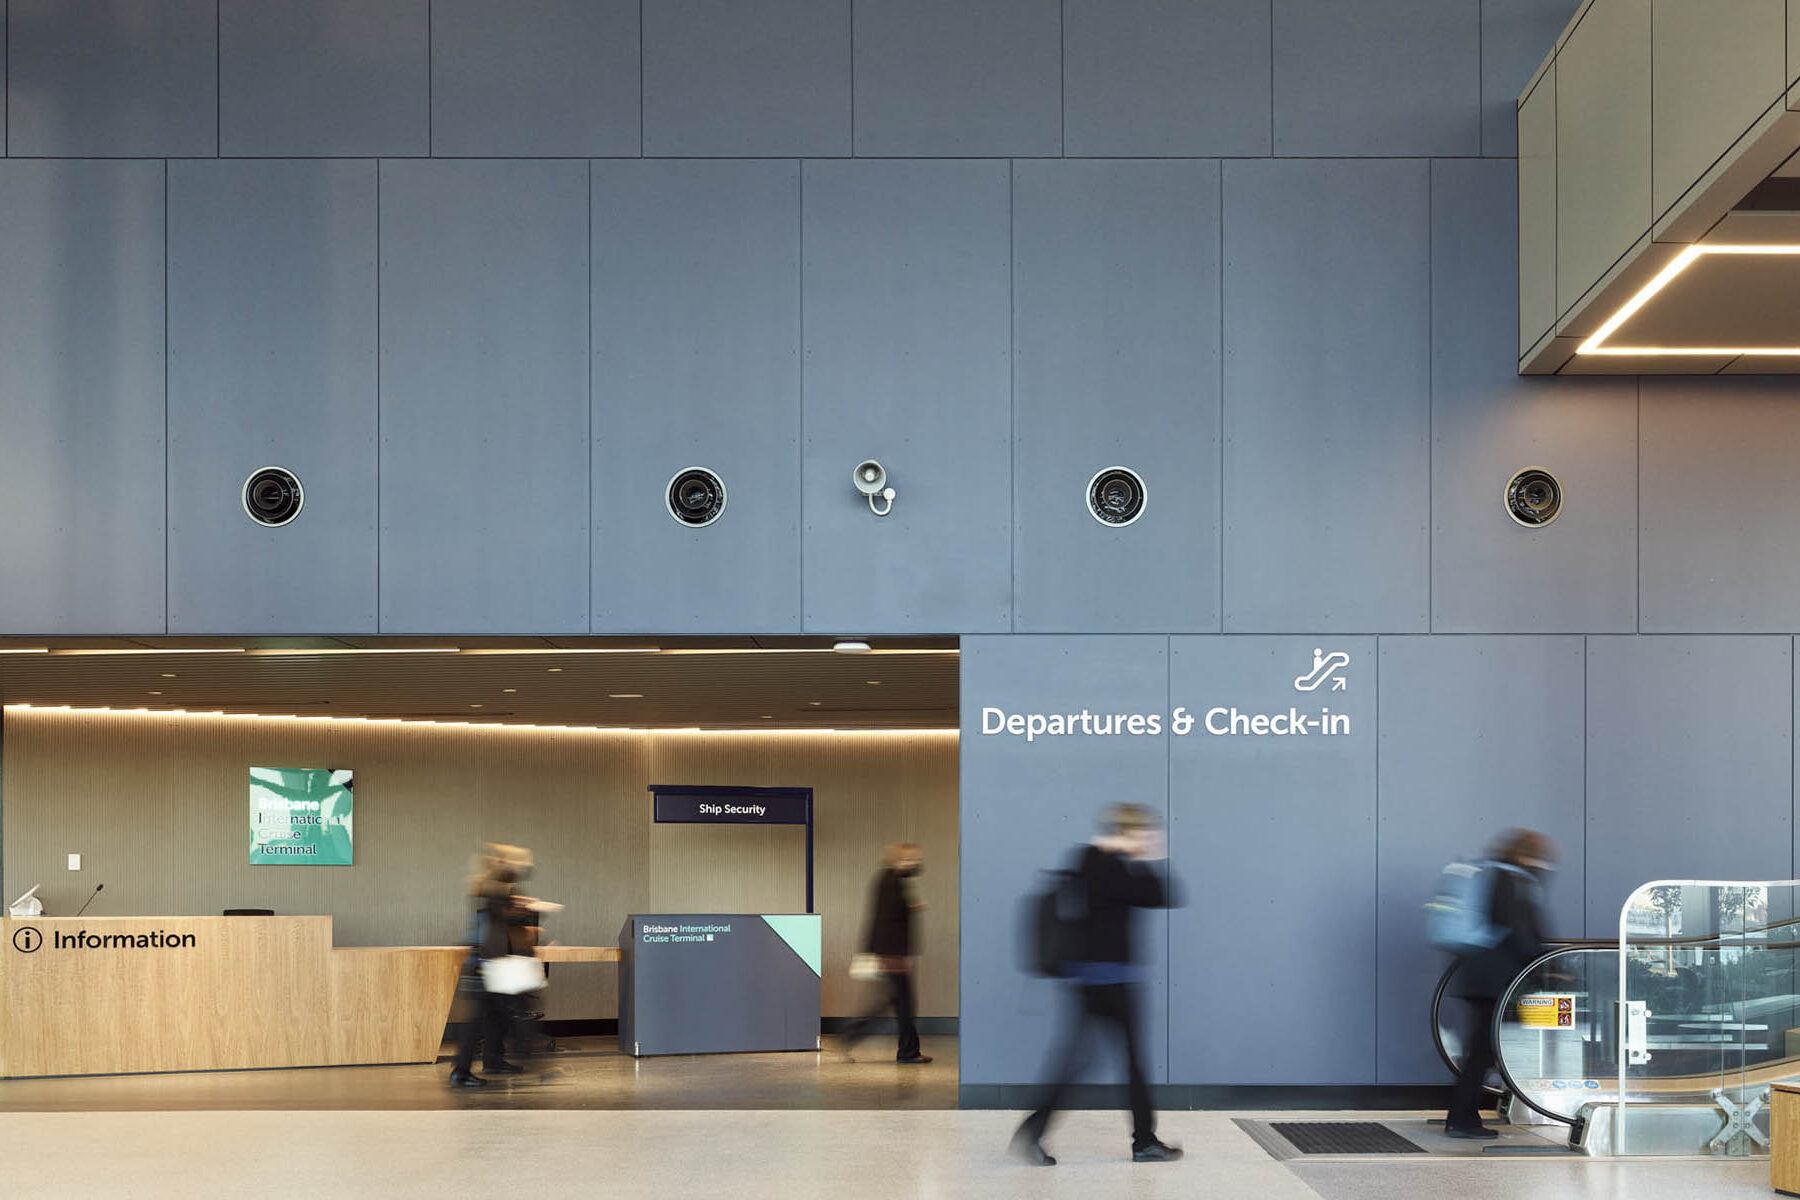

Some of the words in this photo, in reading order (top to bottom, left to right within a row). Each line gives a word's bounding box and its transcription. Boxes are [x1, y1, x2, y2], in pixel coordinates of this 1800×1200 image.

[981, 707, 1162, 741] Departures
[1171, 707, 1194, 735] &
[1205, 707, 1350, 735] Check-in
[699, 804, 722, 816] Ship
[724, 804, 766, 817] Security
[258, 843, 317, 855] Terminal
[643, 925, 678, 933] Brisbane
[679, 924, 731, 933] International
[54, 930, 196, 949] Information
[643, 934, 669, 942] Cruise
[670, 934, 705, 942] Terminal
